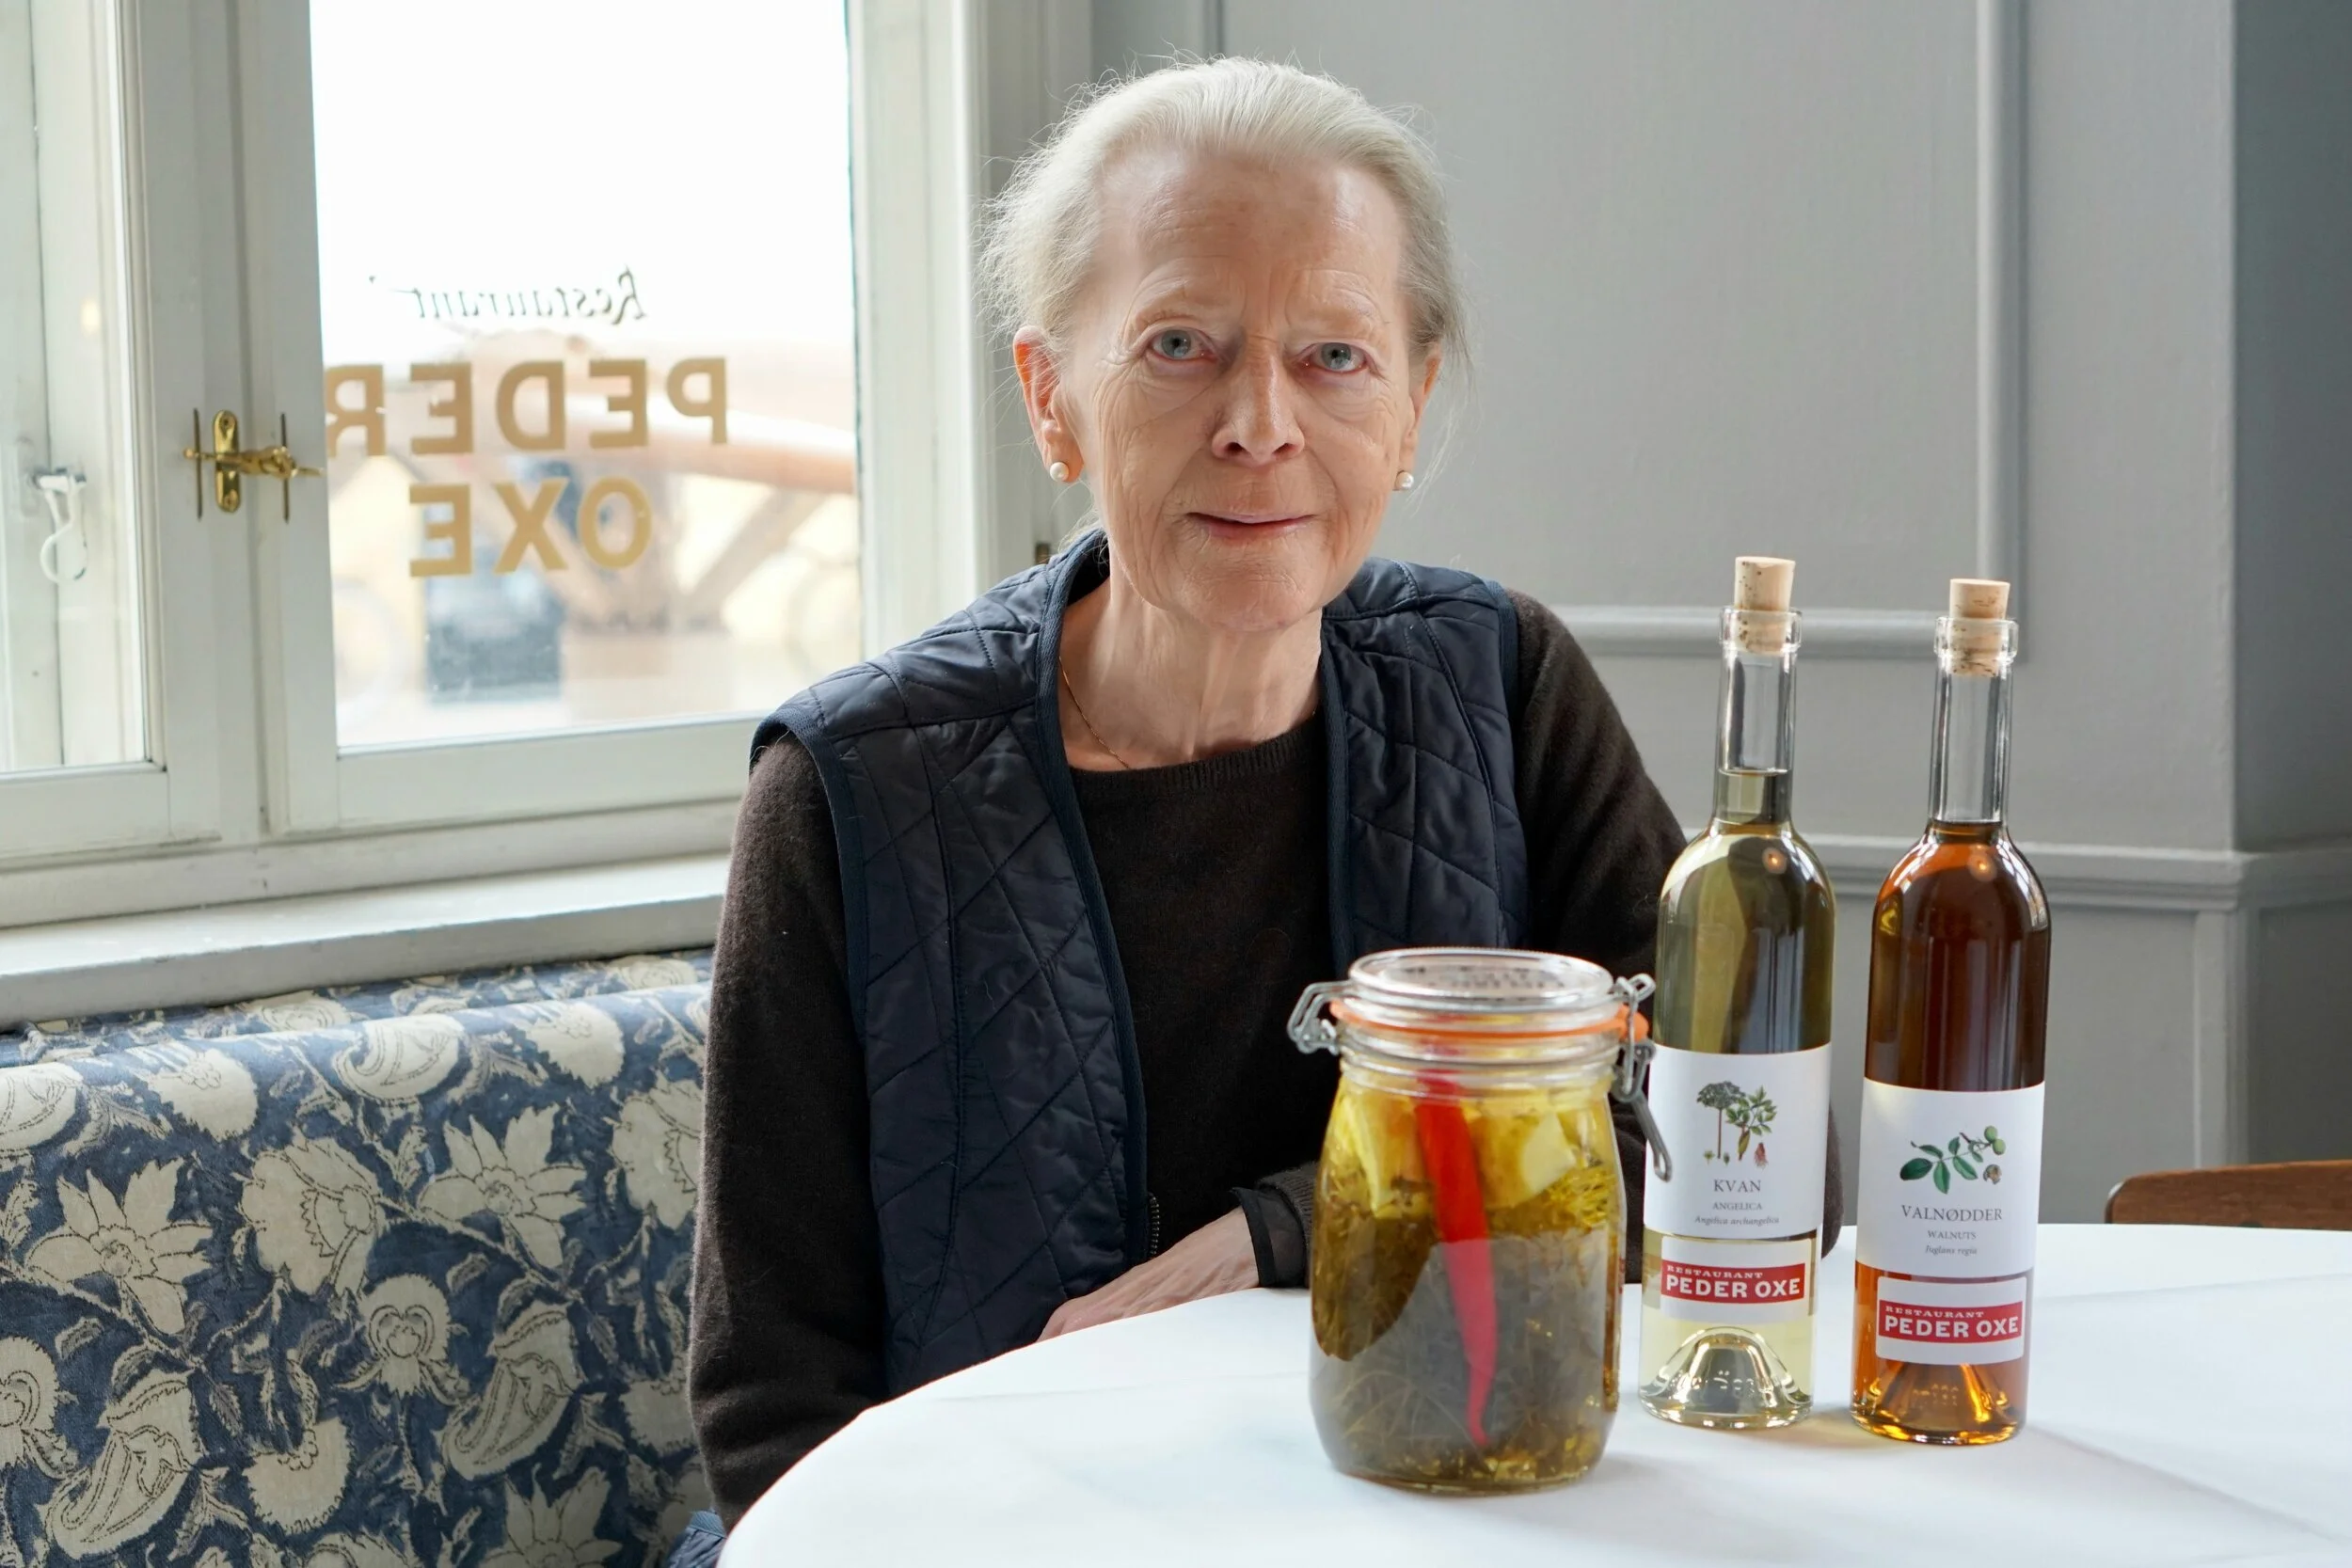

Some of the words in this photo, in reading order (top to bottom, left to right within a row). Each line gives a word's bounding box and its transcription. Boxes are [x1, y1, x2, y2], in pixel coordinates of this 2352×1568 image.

[1714, 1180, 1761, 1192] KVAN
[1712, 1202, 1762, 1211] ANGELICA
[1901, 1205, 2002, 1222] VALNØDDER
[1928, 1230, 1977, 1240] WALNUTS
[1667, 1265, 1763, 1278] RESTAURANT
[1666, 1275, 1747, 1298] PEDER
[1755, 1278, 1801, 1298] OXE
[1885, 1306, 1984, 1318] RESTAURANT
[1884, 1316, 1968, 1338] PEDER
[1977, 1316, 2018, 1337] OXE
